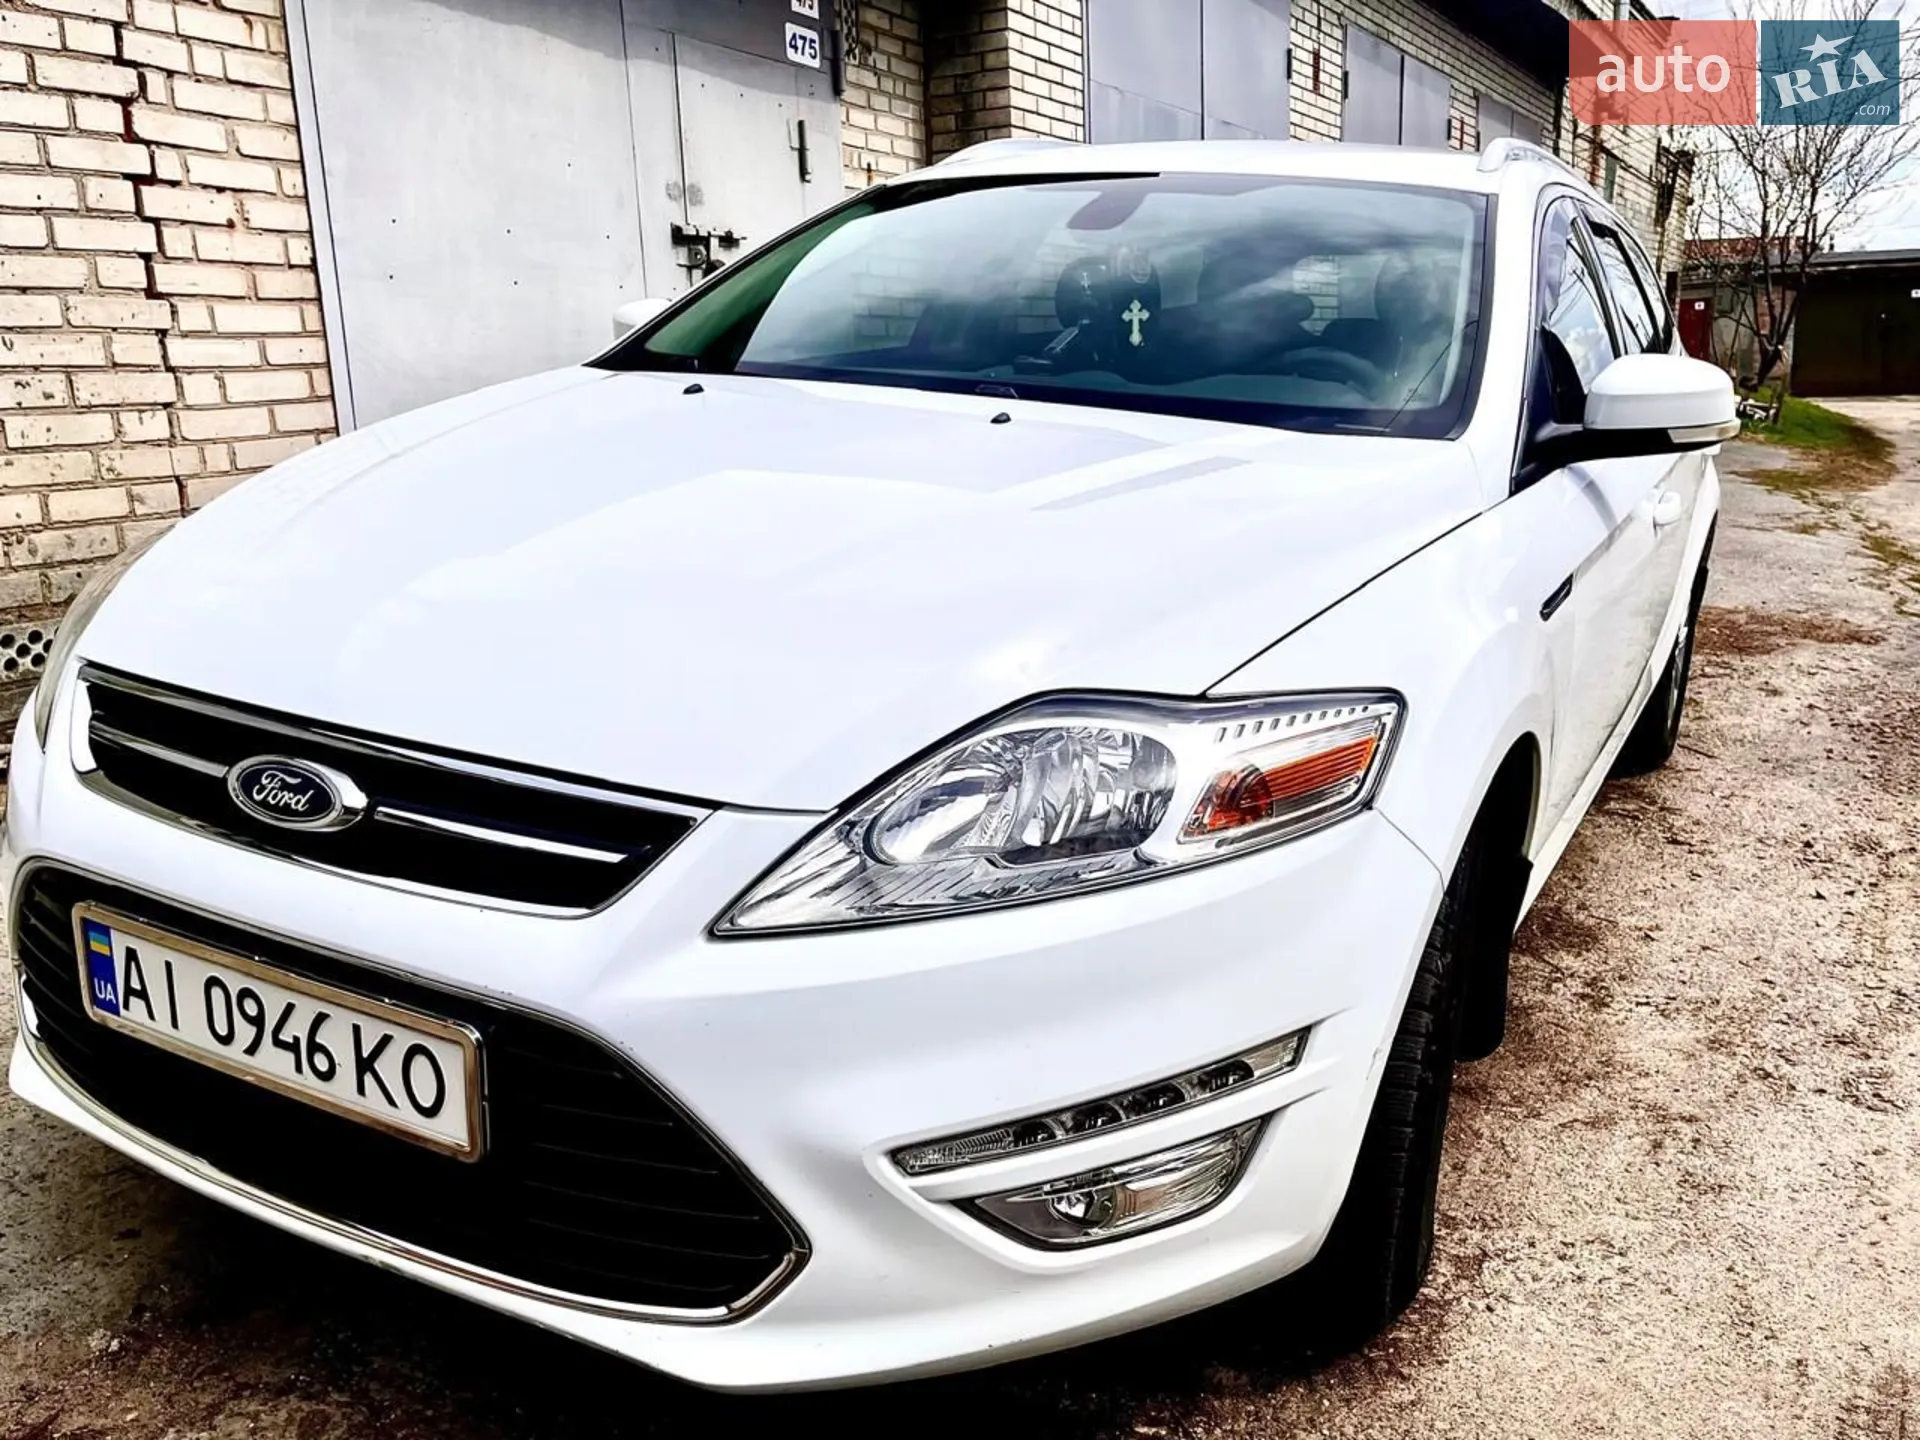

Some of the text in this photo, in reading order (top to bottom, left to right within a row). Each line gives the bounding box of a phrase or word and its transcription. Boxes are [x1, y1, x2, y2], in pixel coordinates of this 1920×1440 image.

[789, 33, 817, 60] 475
[252, 770, 314, 812] Ford
[95, 979, 116, 1004] UA
[122, 946, 446, 1118] AI 0946 KO
